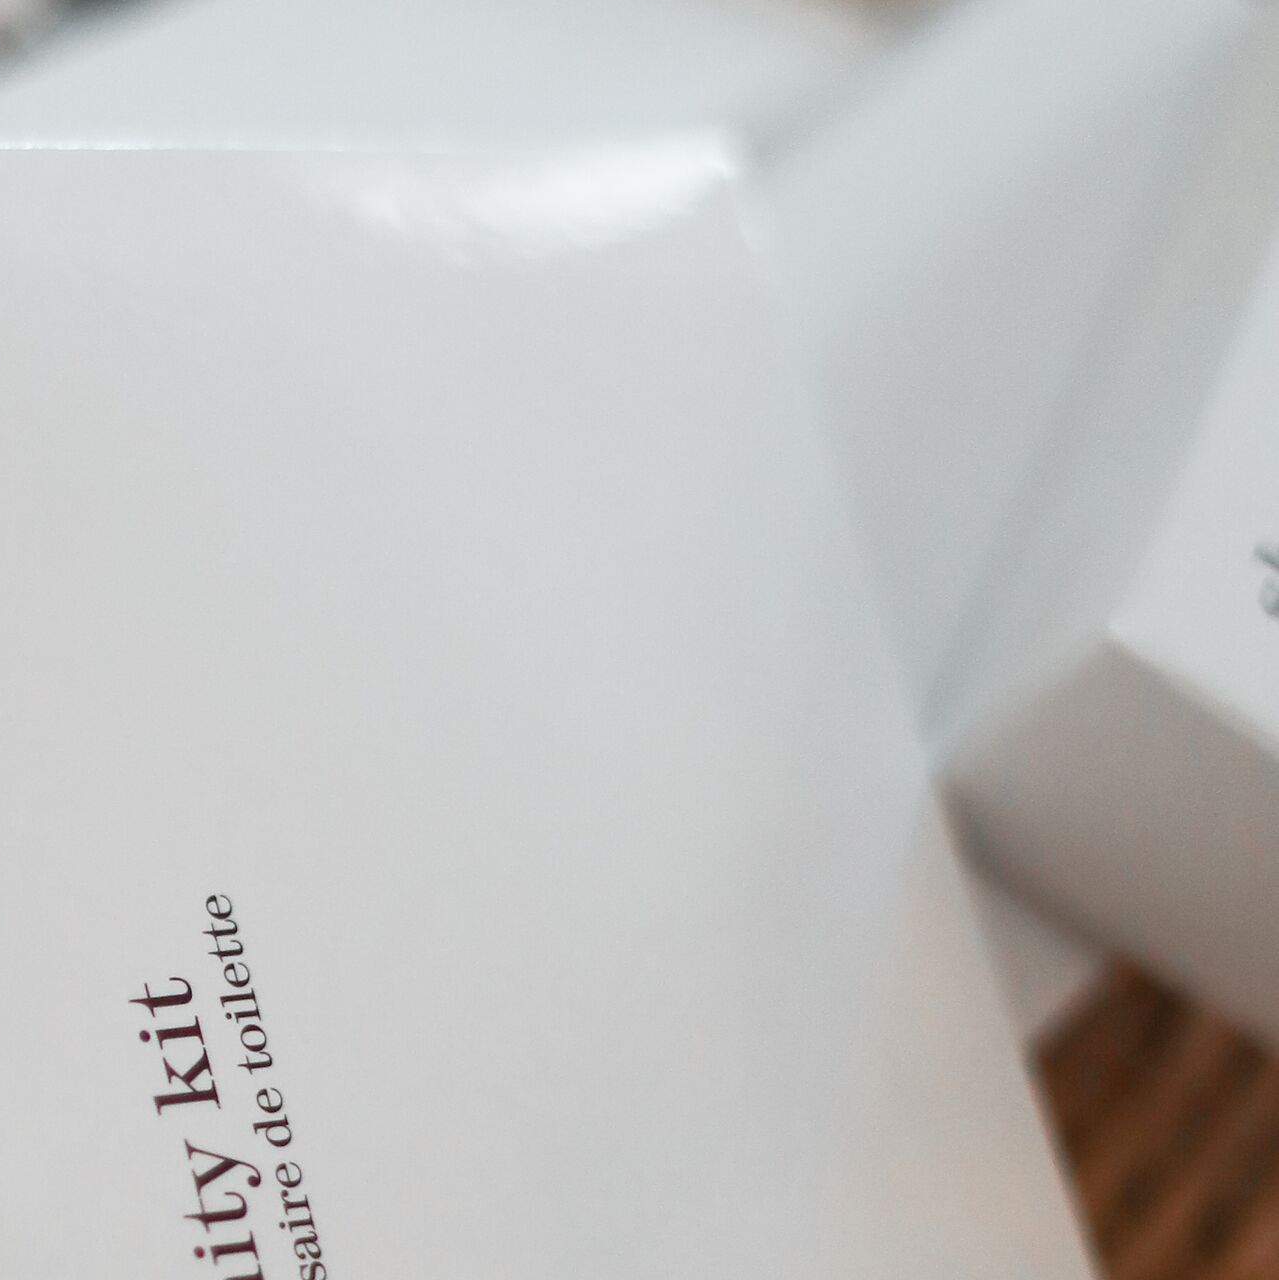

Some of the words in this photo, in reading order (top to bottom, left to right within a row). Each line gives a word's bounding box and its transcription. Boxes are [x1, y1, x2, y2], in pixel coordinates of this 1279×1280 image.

[127, 976, 222, 1116] kit
[202, 893, 274, 1076] toilette
[252, 1086, 294, 1149] de
